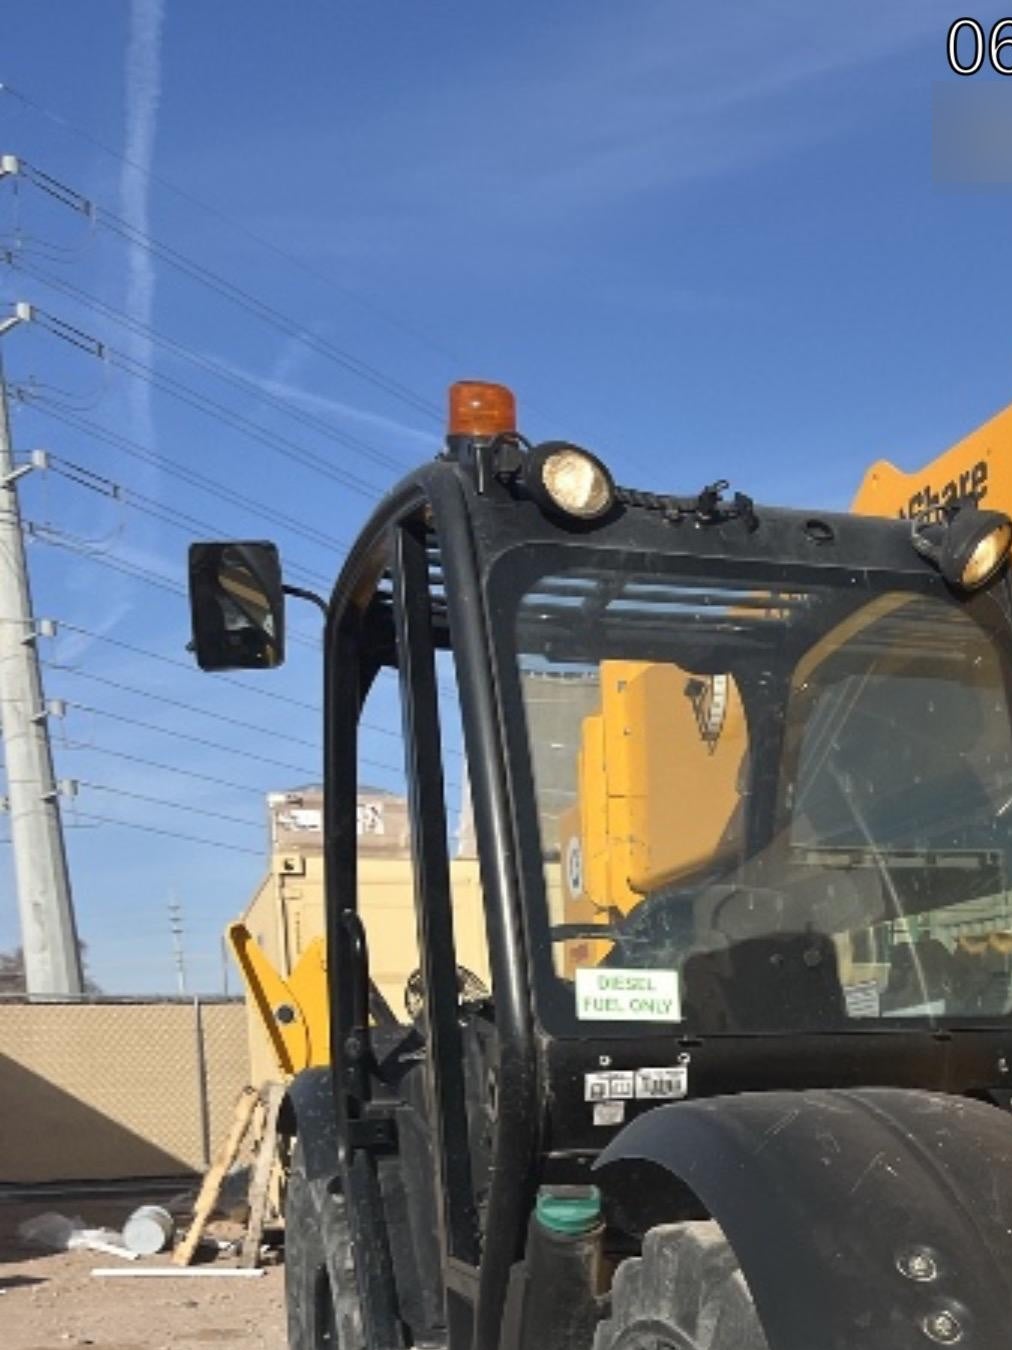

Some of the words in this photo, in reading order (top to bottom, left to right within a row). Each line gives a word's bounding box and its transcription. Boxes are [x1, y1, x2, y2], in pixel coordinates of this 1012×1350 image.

[597, 975, 657, 991] DIESEL
[584, 998, 625, 1012] FUEL
[629, 997, 673, 1015] ONLY
